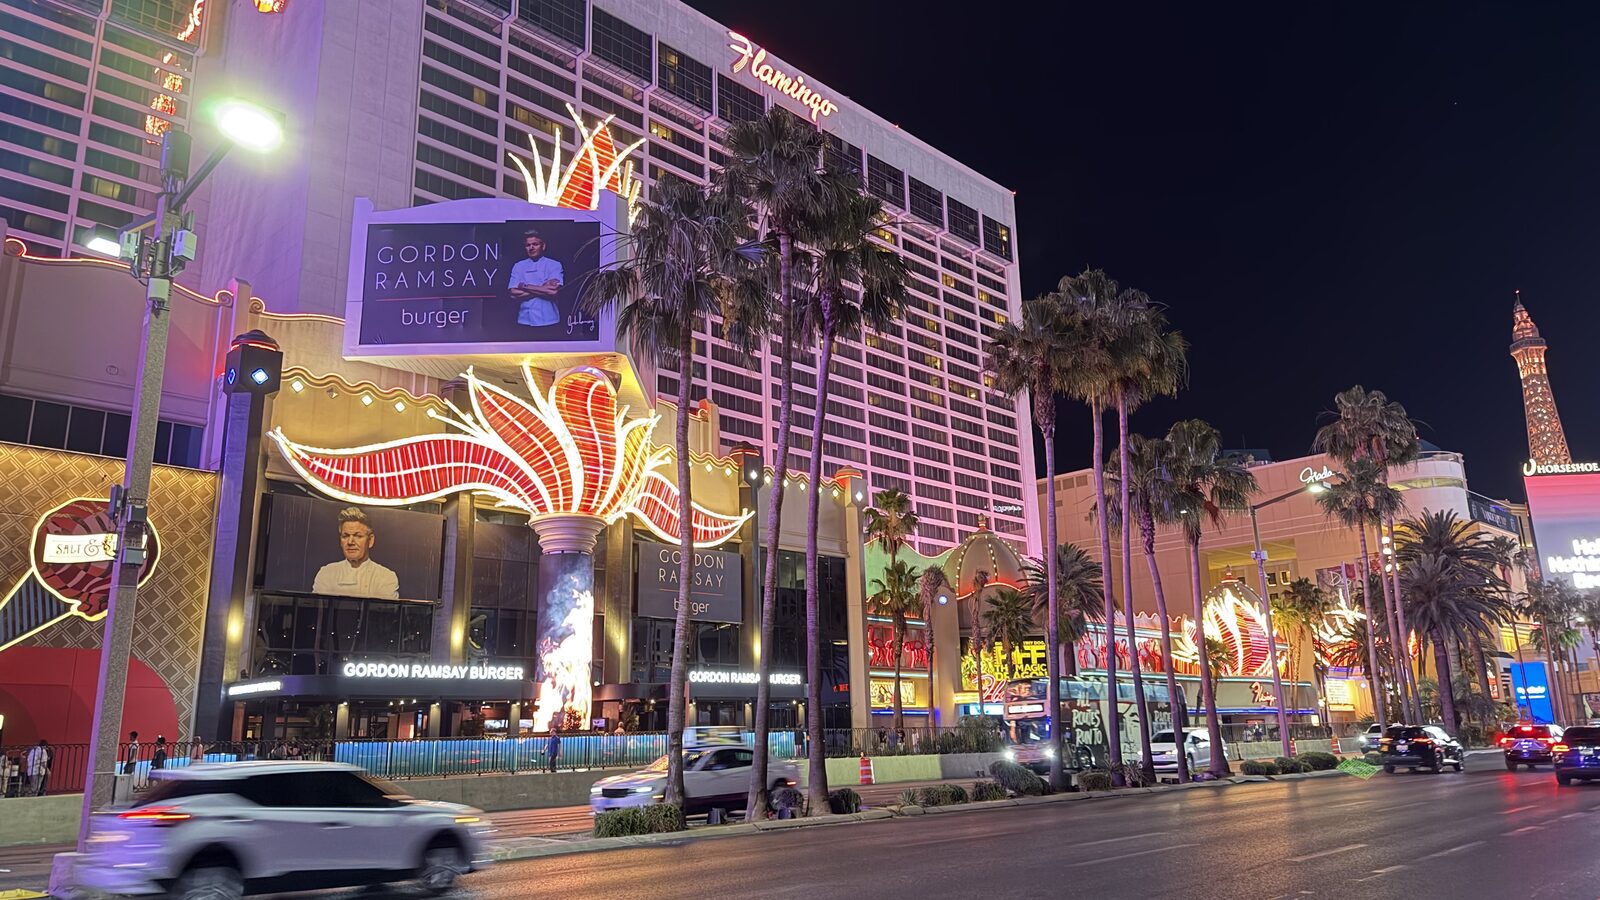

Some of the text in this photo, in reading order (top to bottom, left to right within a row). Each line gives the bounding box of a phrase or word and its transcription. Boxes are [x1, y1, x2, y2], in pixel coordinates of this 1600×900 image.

[728, 31, 838, 122] Flamingo
[377, 243, 498, 264] GORDON
[375, 268, 498, 290] RAMSAY
[401, 308, 469, 328] burger
[1537, 462, 1600, 474] HORSESHOE
[659, 549, 724, 570] GODON
[658, 568, 724, 588] RASAY
[673, 598, 710, 616] bger
[343, 663, 524, 680] GORDON RAMSAY BURGER
[1016, 663, 1047, 672] MAGIC
[689, 671, 801, 685] GORDON RAMSA URGER
[1072, 709, 1100, 728] ROUTES
